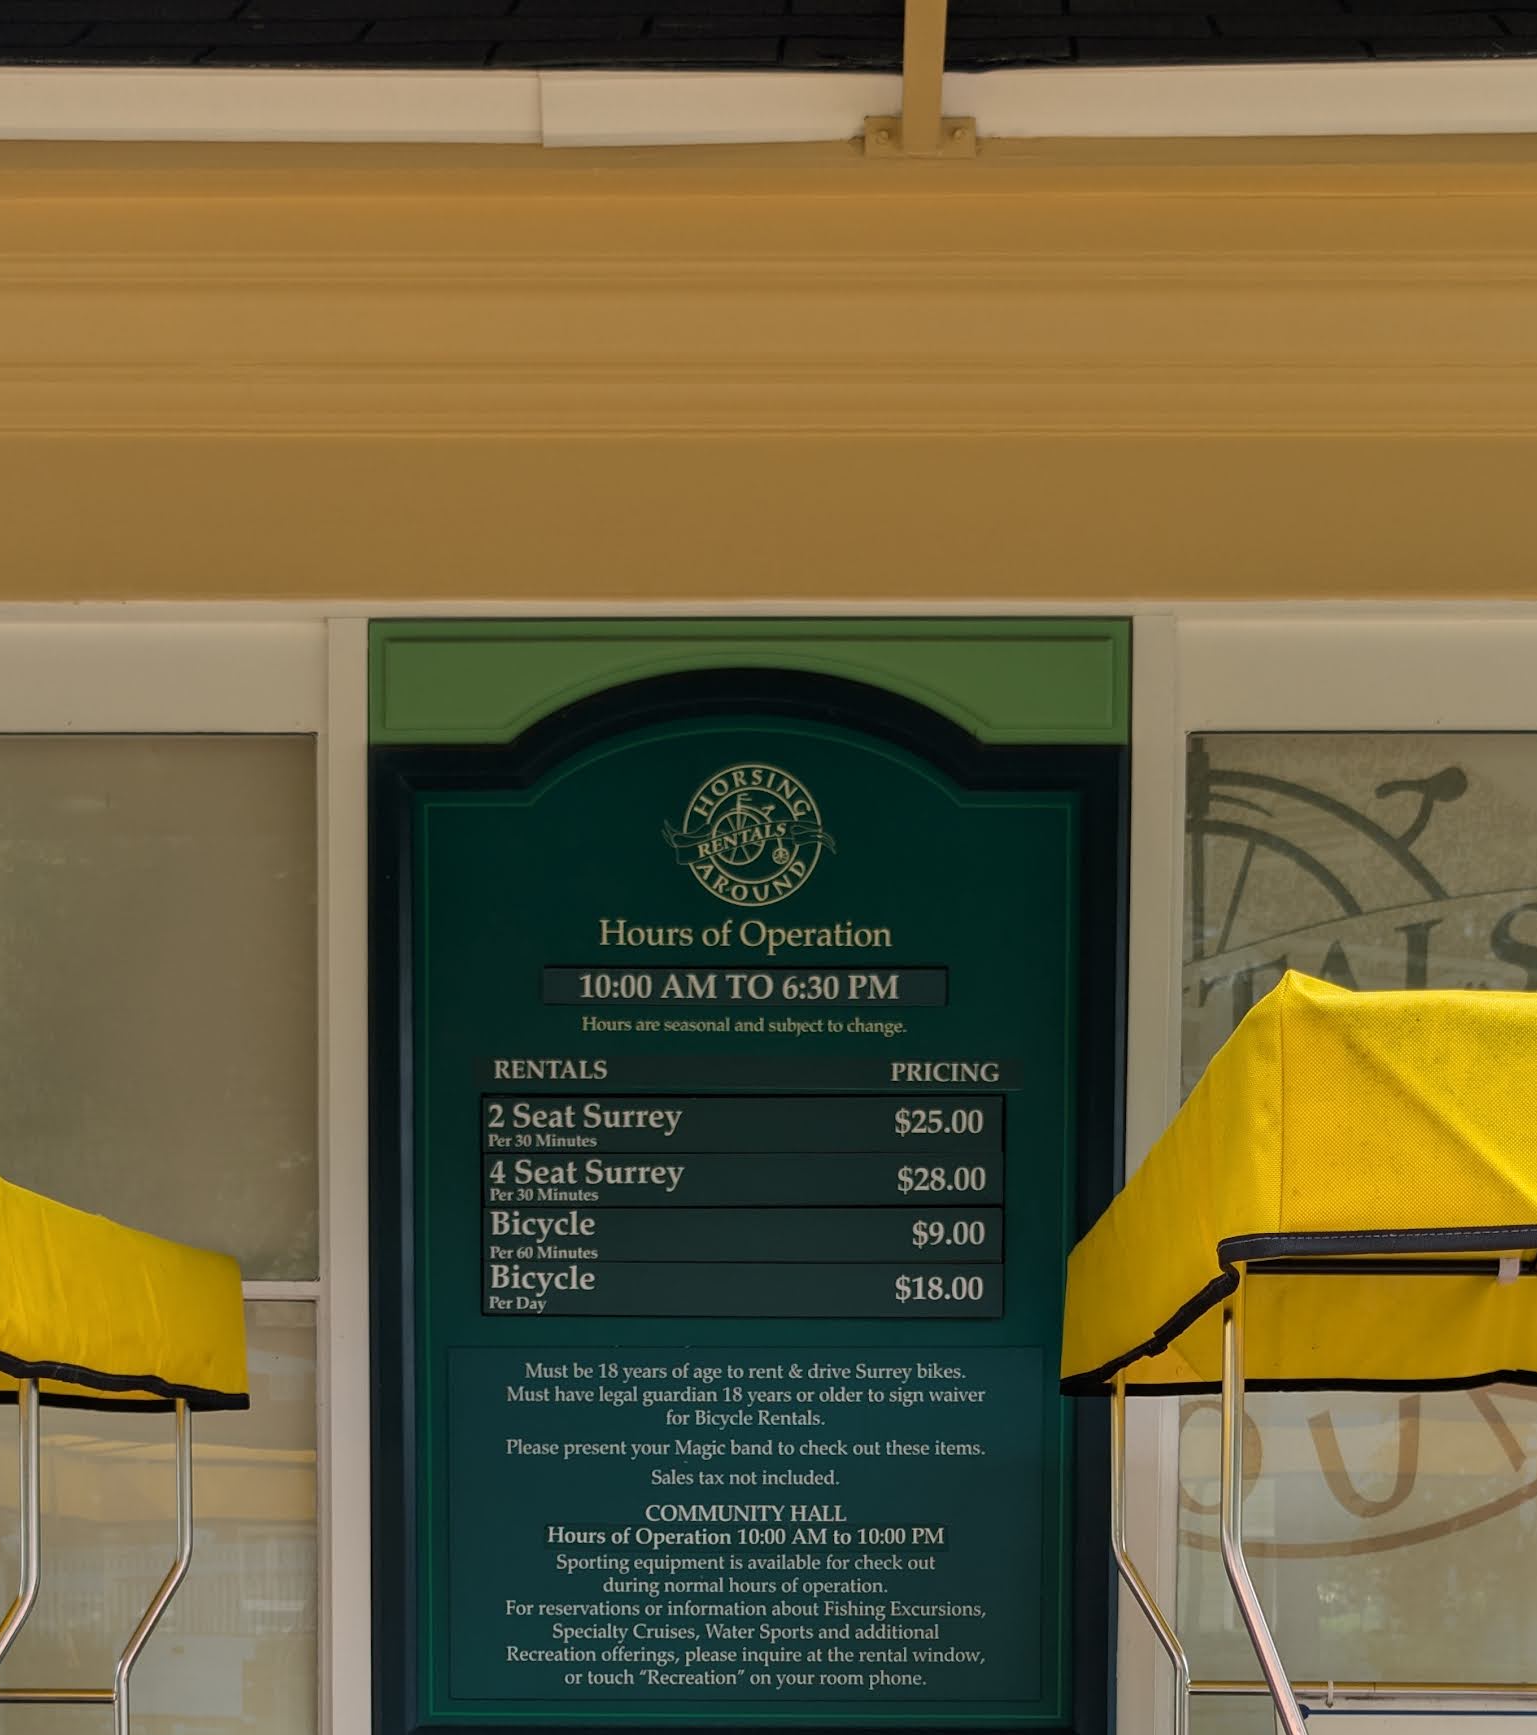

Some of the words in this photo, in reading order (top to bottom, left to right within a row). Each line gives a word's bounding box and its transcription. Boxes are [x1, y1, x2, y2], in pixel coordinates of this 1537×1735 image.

[693, 769, 811, 817] HORSING
[698, 822, 787, 858] RENTALS
[695, 860, 807, 902] AROUND
[598, 919, 694, 947] Hours
[701, 918, 734, 947] of
[739, 919, 893, 957] Operation
[579, 973, 653, 999] 10:00
[659, 973, 718, 1000] AM
[724, 973, 775, 1000] TO
[781, 974, 840, 1001] 6:30
[847, 974, 900, 1000] PM
[581, 1015, 633, 1032] Hours
[634, 1019, 662, 1032] are
[663, 1016, 731, 1033] seasonal
[733, 1016, 765, 1033] and
[767, 1016, 825, 1037] subject
[826, 1019, 845, 1033] to
[846, 1016, 908, 1038] change.
[493, 1059, 608, 1080] RENTALS
[890, 1062, 1000, 1083] PRICING
[487, 1103, 506, 1129] 2
[512, 1102, 577, 1129] Seat
[582, 1102, 684, 1137] Surrey
[894, 1106, 984, 1138] $25.00
[487, 1133, 513, 1148] Per
[514, 1133, 533, 1148] 30
[534, 1133, 598, 1148] Minutes
[488, 1159, 507, 1185] 4
[514, 1158, 579, 1185] Seat
[584, 1158, 686, 1193] Surrey
[897, 1165, 987, 1196] $28.00
[489, 1187, 515, 1202] Per
[515, 1187, 535, 1202] 30
[536, 1187, 600, 1202] Minutes
[489, 1209, 596, 1244] Bicycle
[911, 1219, 986, 1250] $9.00
[489, 1245, 515, 1260] Per
[515, 1245, 534, 1260] 60
[536, 1245, 599, 1260] Minutes
[489, 1263, 596, 1298] Bicycle
[894, 1273, 984, 1304] $18.00
[488, 1295, 514, 1310] Per
[515, 1295, 548, 1315] Day
[524, 1362, 569, 1379] Must
[572, 1361, 594, 1379] be
[597, 1362, 619, 1379] 18
[622, 1366, 668, 1384] years
[671, 1361, 691, 1380] of
[692, 1367, 723, 1385] age
[726, 1364, 745, 1380] to
[747, 1364, 785, 1380] rent
[787, 1362, 804, 1380] &
[807, 1362, 852, 1380] drive
[855, 1362, 913, 1385] Surrey
[916, 1362, 967, 1380] bikes.
[506, 1385, 551, 1403] Must
[554, 1385, 595, 1403] have
[598, 1385, 639, 1408] legal
[641, 1385, 719, 1408] guardian
[722, 1386, 744, 1403] 18
[746, 1390, 793, 1408] years
[795, 1390, 816, 1403] or
[818, 1385, 864, 1403] older
[867, 1387, 886, 1403] to
[888, 1386, 925, 1408] sign
[928, 1386, 987, 1403] waiver
[665, 1408, 691, 1426] for
[694, 1408, 754, 1431] Bicycle
[757, 1408, 826, 1426] Rentals.
[505, 1438, 560, 1456] Please
[563, 1440, 628, 1461] present
[630, 1443, 671, 1461] your
[674, 1438, 727, 1461] Magic
[729, 1438, 774, 1456] band
[777, 1440, 796, 1456] to
[798, 1439, 849, 1456] check
[852, 1441, 882, 1456] out
[885, 1439, 931, 1456] these
[934, 1439, 986, 1456] items.
[650, 1468, 695, 1486] Sales
[698, 1470, 725, 1486] tax
[728, 1471, 758, 1486] not
[761, 1468, 841, 1486] included.
[644, 1503, 786, 1523] COMMUNITY
[789, 1504, 848, 1523] HALL
[547, 1525, 607, 1545] Hours
[610, 1526, 633, 1545] of
[634, 1527, 733, 1551] Operation
[736, 1527, 787, 1545] 10:00
[790, 1527, 828, 1545] AM
[832, 1529, 853, 1546] to
[856, 1527, 907, 1545] 10:00
[911, 1527, 945, 1545] PM
[505, 1599, 535, 1616] For
[538, 1600, 641, 1617] reservations
[644, 1604, 664, 1617] or
[667, 1599, 768, 1617] information
[771, 1599, 820, 1617] about
[823, 1599, 887, 1622] Fishing
[889, 1600, 987, 1619] Excursions,
[552, 1622, 630, 1645] Specialty
[632, 1622, 701, 1642] Cruises,
[704, 1622, 756, 1640] Water
[759, 1622, 815, 1645] Sports
[817, 1622, 851, 1640] and
[854, 1622, 940, 1640] additional
[506, 1645, 597, 1662] Recreation
[600, 1645, 681, 1668] offerings,
[684, 1645, 738, 1668] please
[741, 1646, 803, 1668] inquire
[806, 1648, 823, 1663] at
[827, 1645, 855, 1663] the
[858, 1646, 908, 1663] rental
[911, 1646, 986, 1665] window,
[563, 1672, 584, 1685] or
[587, 1668, 635, 1686] touch
[749, 1673, 772, 1686] on
[775, 1673, 816, 1691] your
[819, 1673, 865, 1686] room
[868, 1668, 927, 1691] phone.
